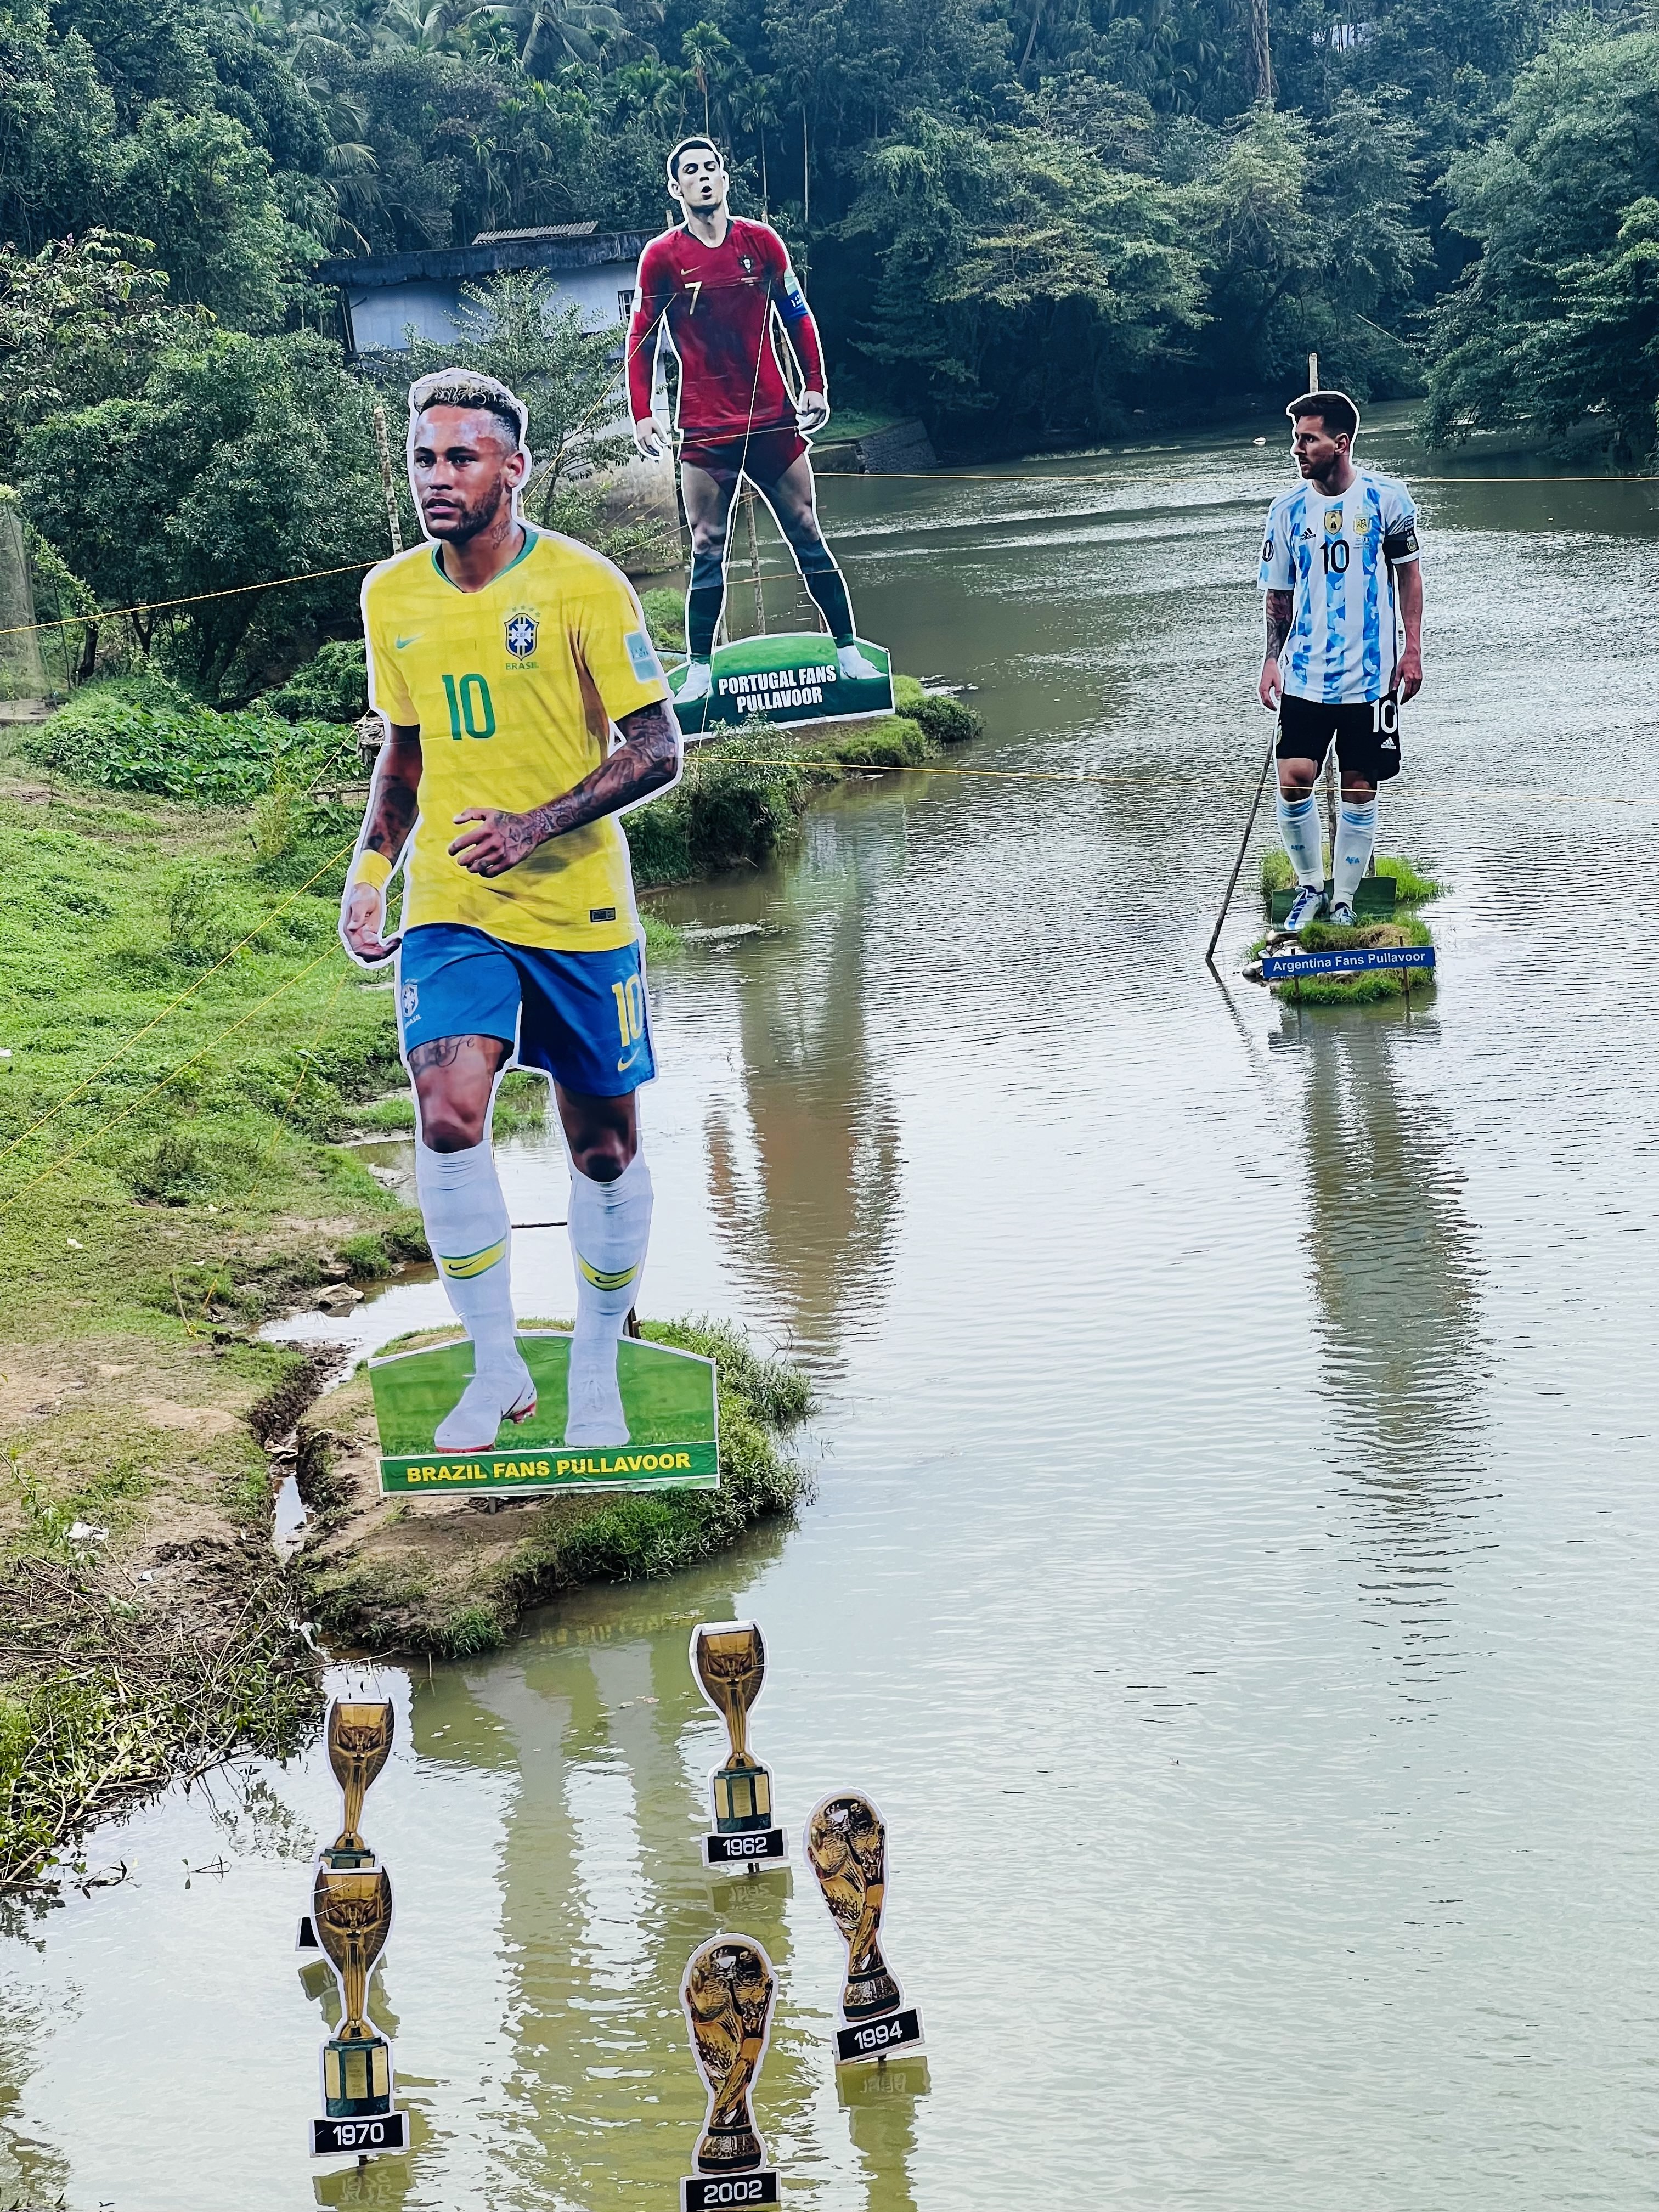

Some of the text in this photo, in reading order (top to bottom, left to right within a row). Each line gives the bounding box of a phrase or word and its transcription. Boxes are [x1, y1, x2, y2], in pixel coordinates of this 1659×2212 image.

[684, 281, 702, 315] 7
[1319, 539, 1350, 575] 10
[505, 661, 540, 670] BRASIL
[718, 665, 837, 695] PORTUGAL FANS
[442, 673, 496, 740] 10
[737, 687, 822, 713] PULLAVOOR
[1370, 699, 1397, 733] 10
[1345, 856, 1360, 865] AFA
[1273, 952, 1426, 973] Argentina Fans Pullavoor
[611, 973, 643, 1047] 10
[407, 1452, 691, 1483] BRAZIL FANS PULLAVOOR
[723, 1836, 768, 1856] 1962
[854, 2021, 903, 2050] 1994
[332, 2123, 385, 2146] 1970
[704, 2180, 763, 2204] 2002
